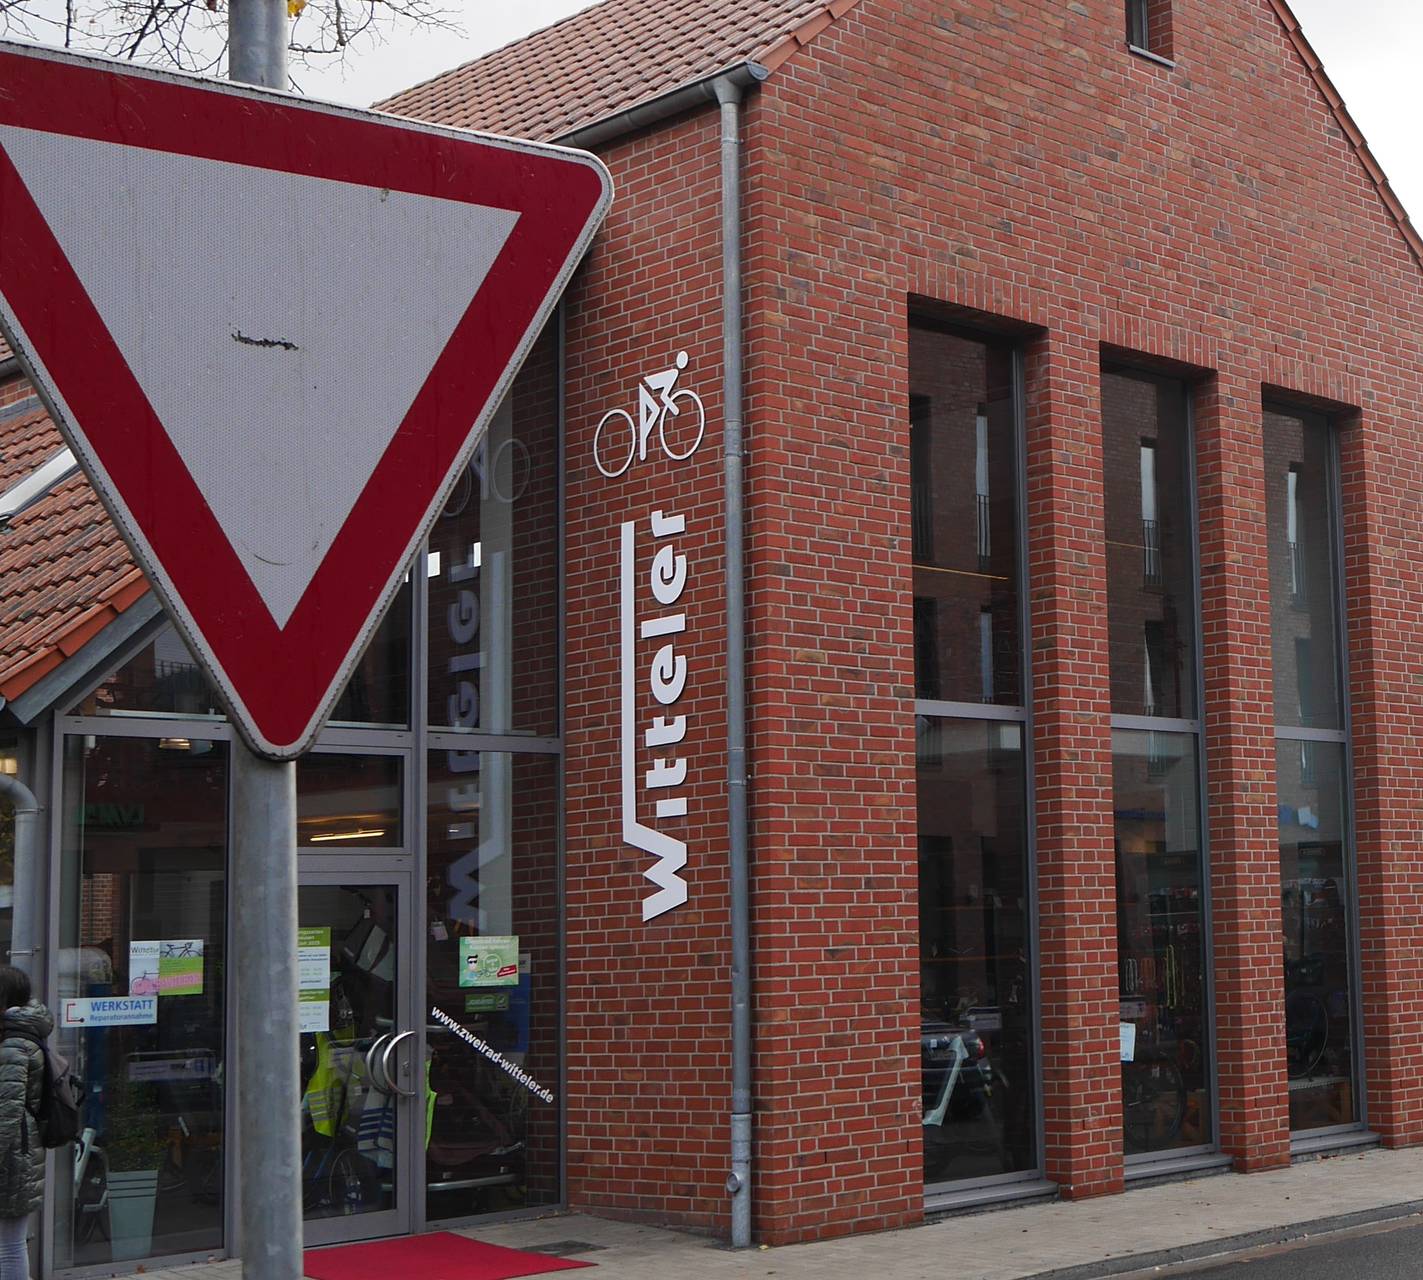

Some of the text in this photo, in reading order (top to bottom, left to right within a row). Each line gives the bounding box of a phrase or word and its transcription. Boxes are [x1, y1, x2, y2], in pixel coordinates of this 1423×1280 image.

[621, 509, 688, 923] Witteler
[90, 999, 153, 1012] WERKSTATT
[431, 1006, 554, 1103] www.zweirad-witteler.de
